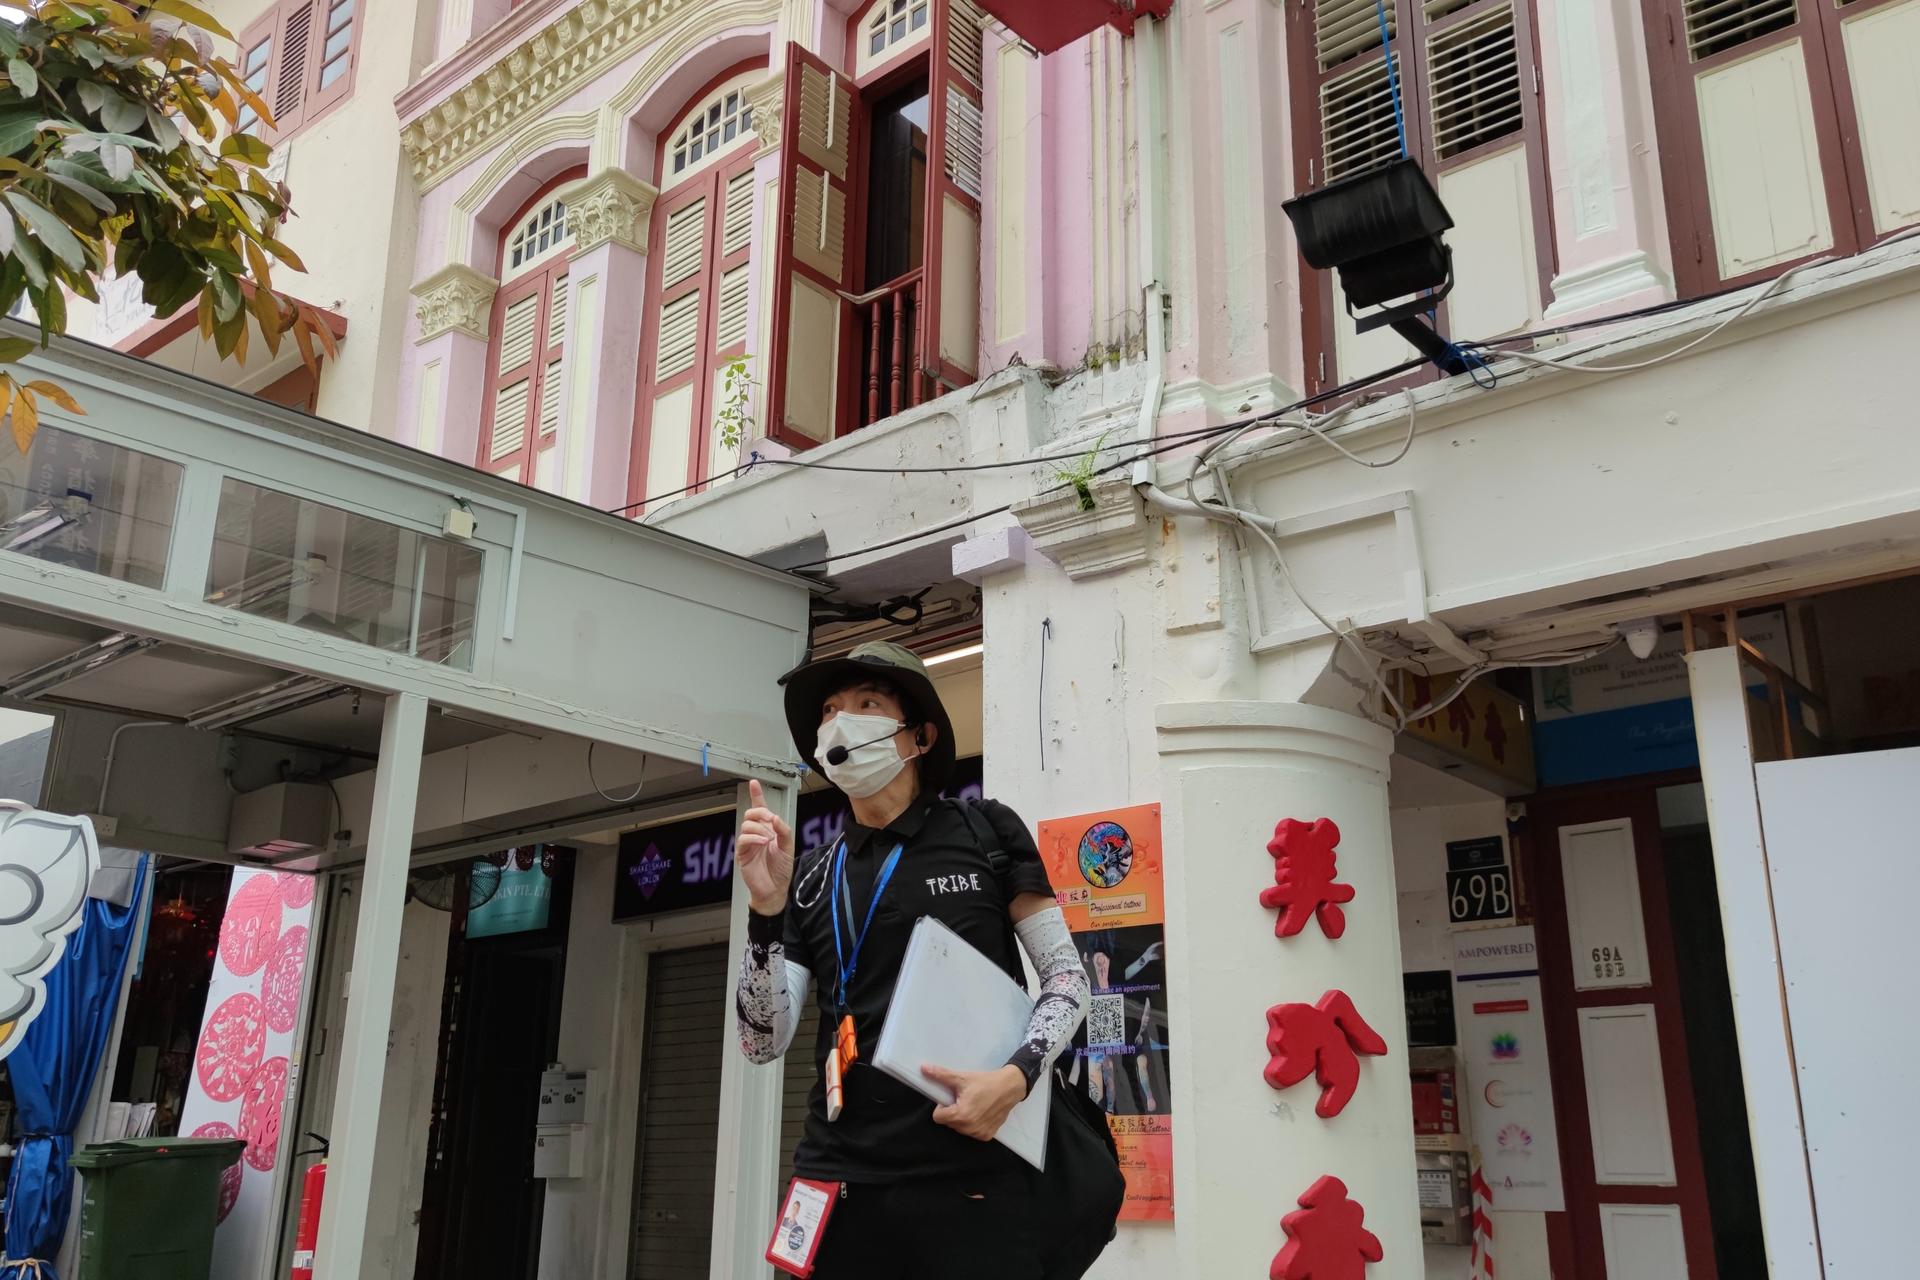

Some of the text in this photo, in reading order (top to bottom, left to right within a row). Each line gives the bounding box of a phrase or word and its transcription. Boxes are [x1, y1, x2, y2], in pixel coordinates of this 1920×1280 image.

[926, 873, 982, 896] TRIBE
[1452, 873, 1510, 918] 69B
[1090, 901, 1123, 914] Professional
[1457, 943, 1535, 960] AMPOWERED
[1592, 946, 1623, 962] 69A
[1123, 983, 1161, 992] appointment
